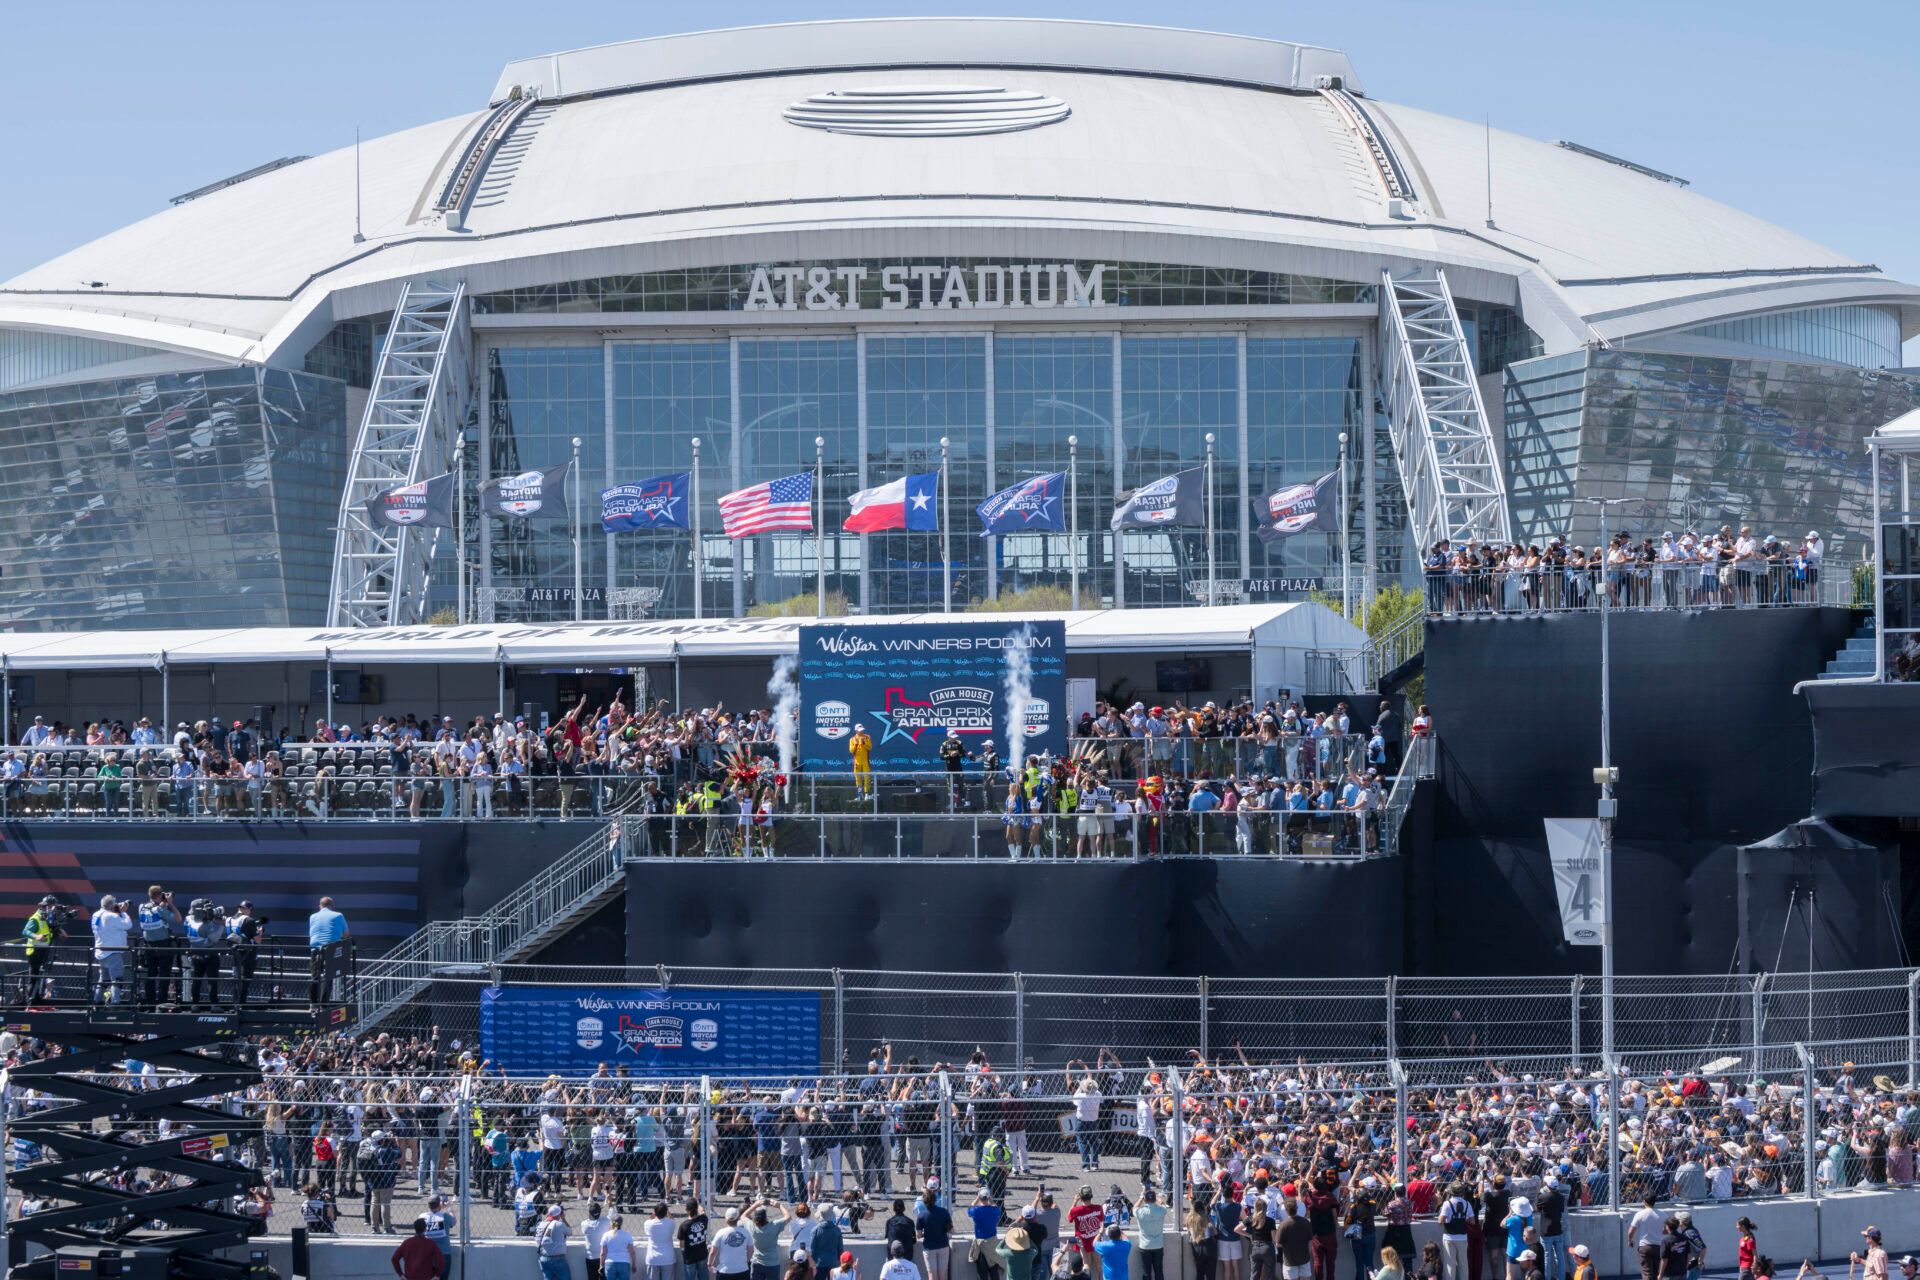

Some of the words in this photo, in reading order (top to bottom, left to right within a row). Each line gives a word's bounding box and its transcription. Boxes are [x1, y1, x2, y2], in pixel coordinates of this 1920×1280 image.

[744, 266, 867, 311] AT&T
[881, 264, 1105, 310] STADIUM
[1249, 580, 1276, 592] AT&T
[1280, 579, 1317, 591] PLAZA
[532, 589, 559, 600] AT&T
[304, 630, 494, 642] WORLD
[497, 627, 584, 639] OF
[590, 623, 800, 636] WINSTA
[816, 628, 879, 656] WinStar
[883, 638, 971, 650] WINNERS
[976, 637, 1050, 649] PODIUM
[935, 690, 956, 701] JAVA
[959, 690, 988, 701] HOUSE
[893, 708, 951, 717] GRAND
[956, 707, 992, 716] PRIX
[898, 717, 992, 727] ARLINGTON
[1567, 858, 1598, 870] SILVER
[1571, 874, 1592, 920] 4
[576, 992, 614, 1012] WinStar
[617, 1001, 670, 1010] WINNERS
[672, 1002, 720, 1011] PODIUM
[648, 1018, 660, 1027] JAVA
[662, 1018, 680, 1026] HOUSE
[1326, 1169, 1336, 1184] 5
